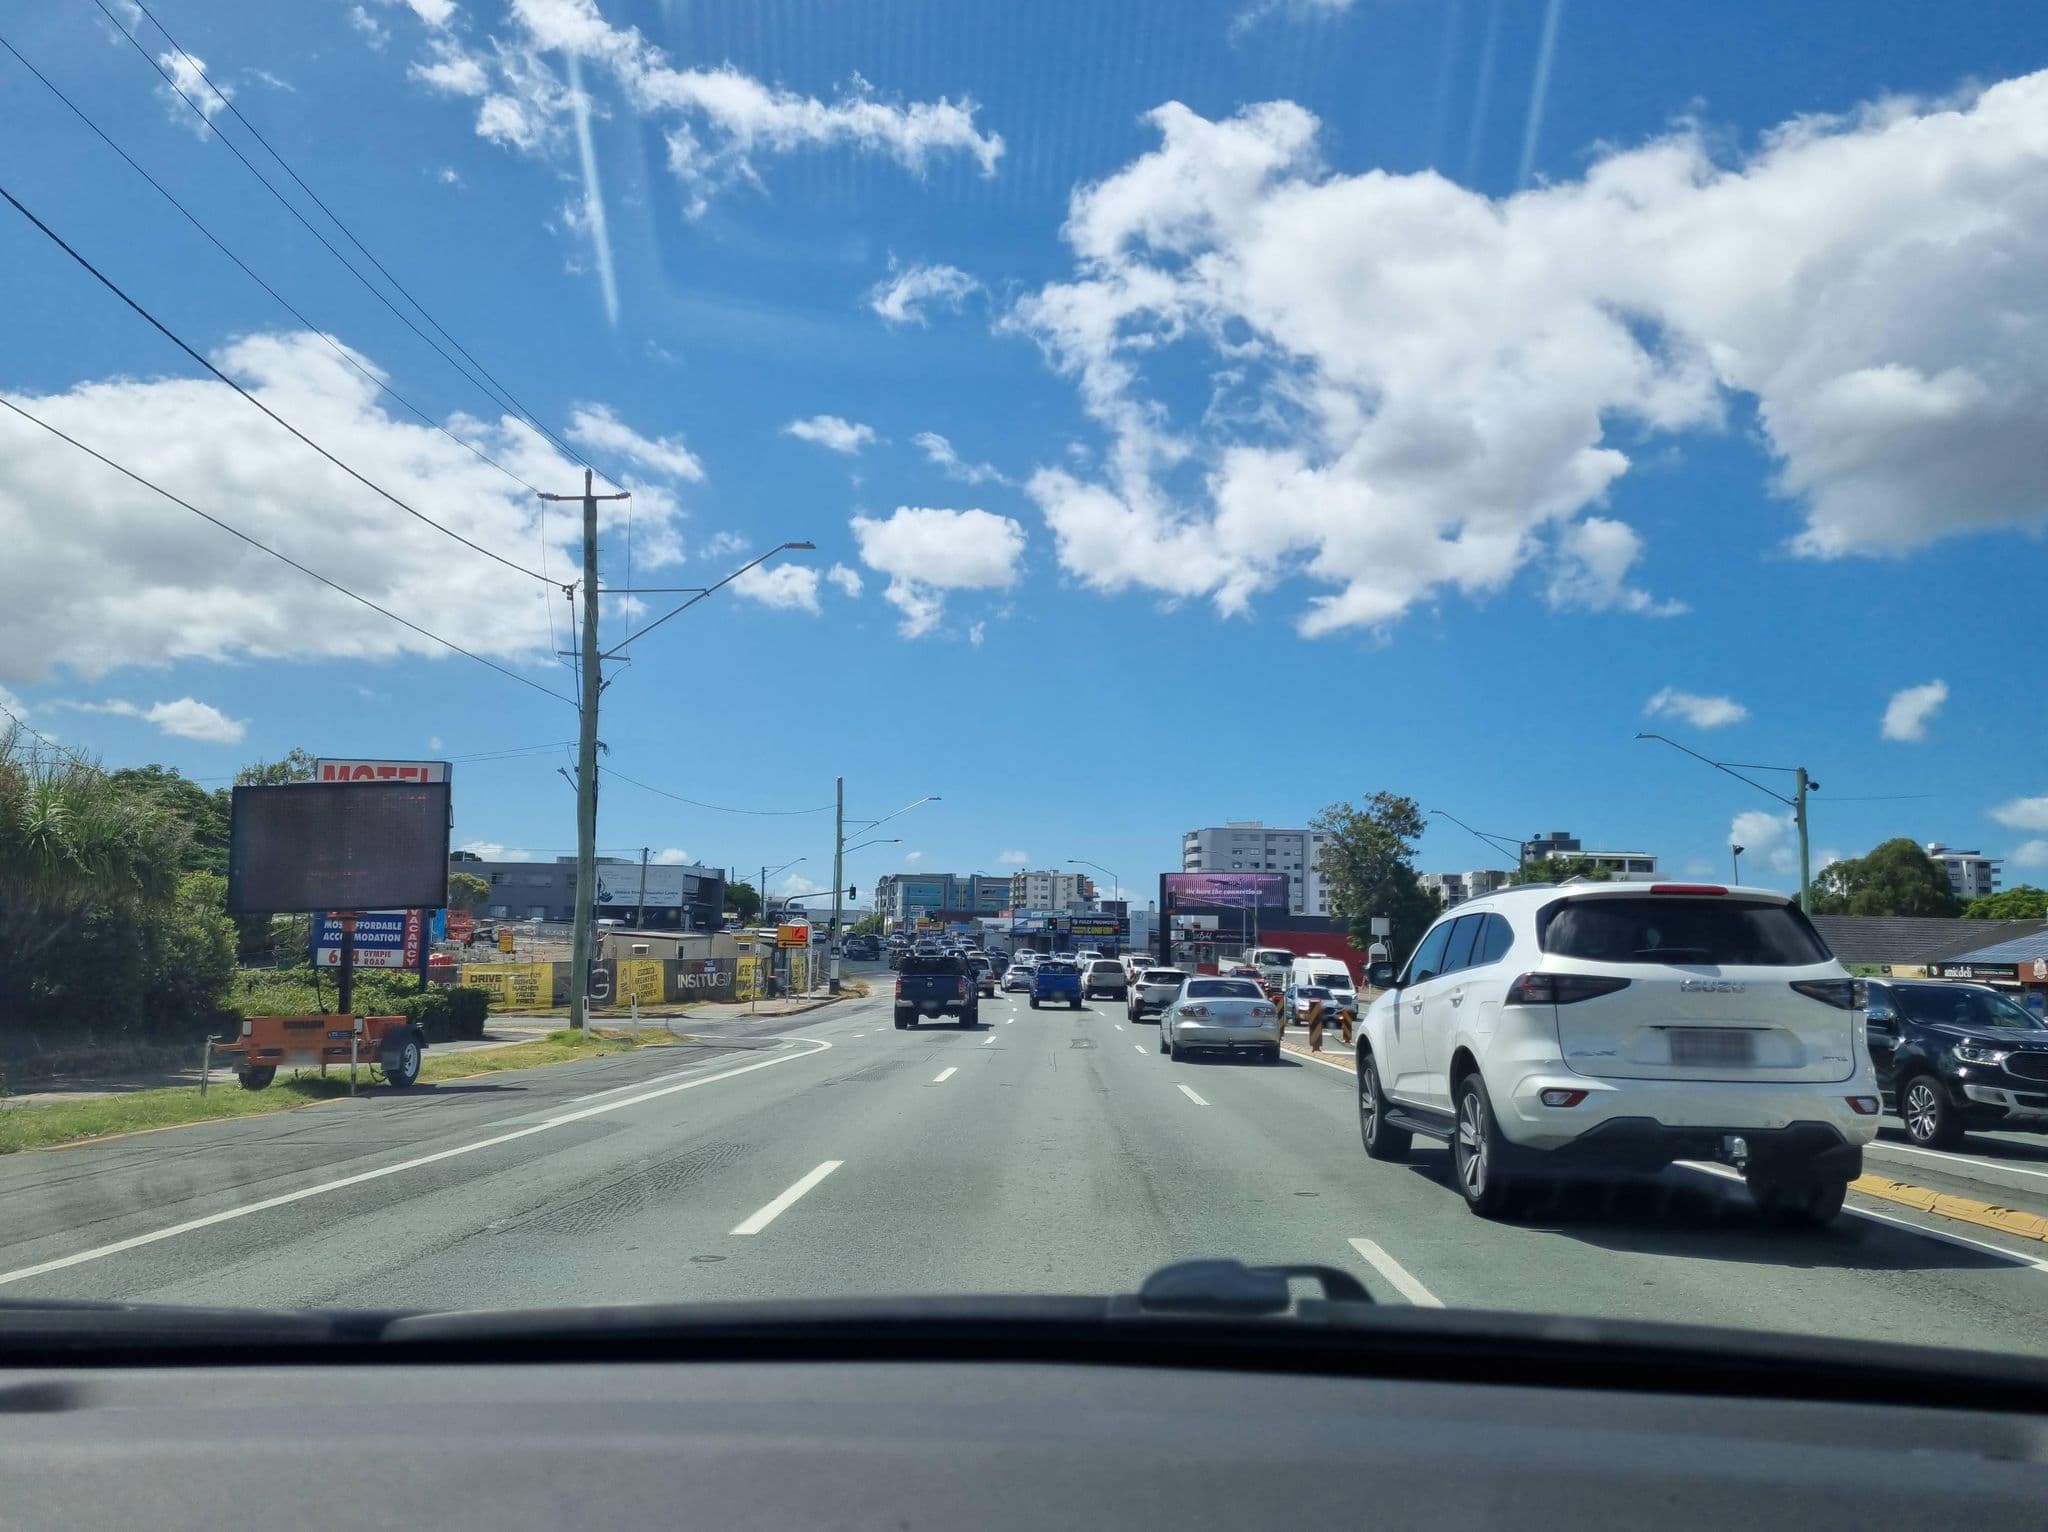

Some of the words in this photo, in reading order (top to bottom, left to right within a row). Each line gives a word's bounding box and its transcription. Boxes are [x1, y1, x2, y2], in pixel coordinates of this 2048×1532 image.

[324, 921, 343, 929] MOS
[355, 921, 402, 930] FFORDABLE
[323, 932, 401, 942] ACCMODATION
[407, 909, 419, 966] VACANCY
[328, 949, 360, 964] 64
[470, 974, 502, 983] DRIVE
[1680, 979, 1746, 993] ISUZU
